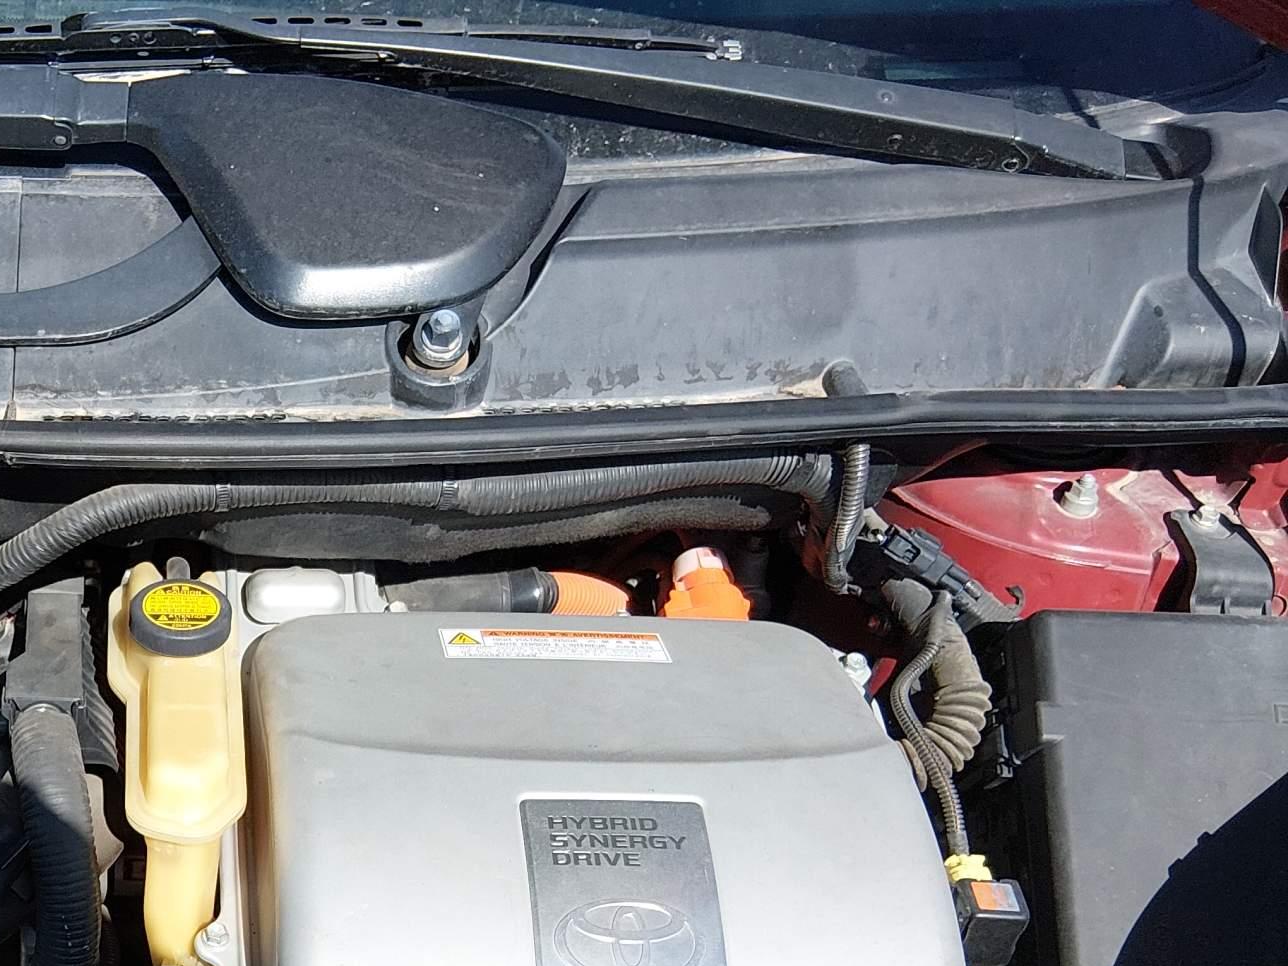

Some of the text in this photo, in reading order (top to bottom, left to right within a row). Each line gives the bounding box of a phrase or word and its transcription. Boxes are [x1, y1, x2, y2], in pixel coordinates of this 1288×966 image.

[547, 816, 659, 832] HYBRID
[549, 833, 687, 850] SYNERGY
[551, 851, 642, 867] DRIVE
